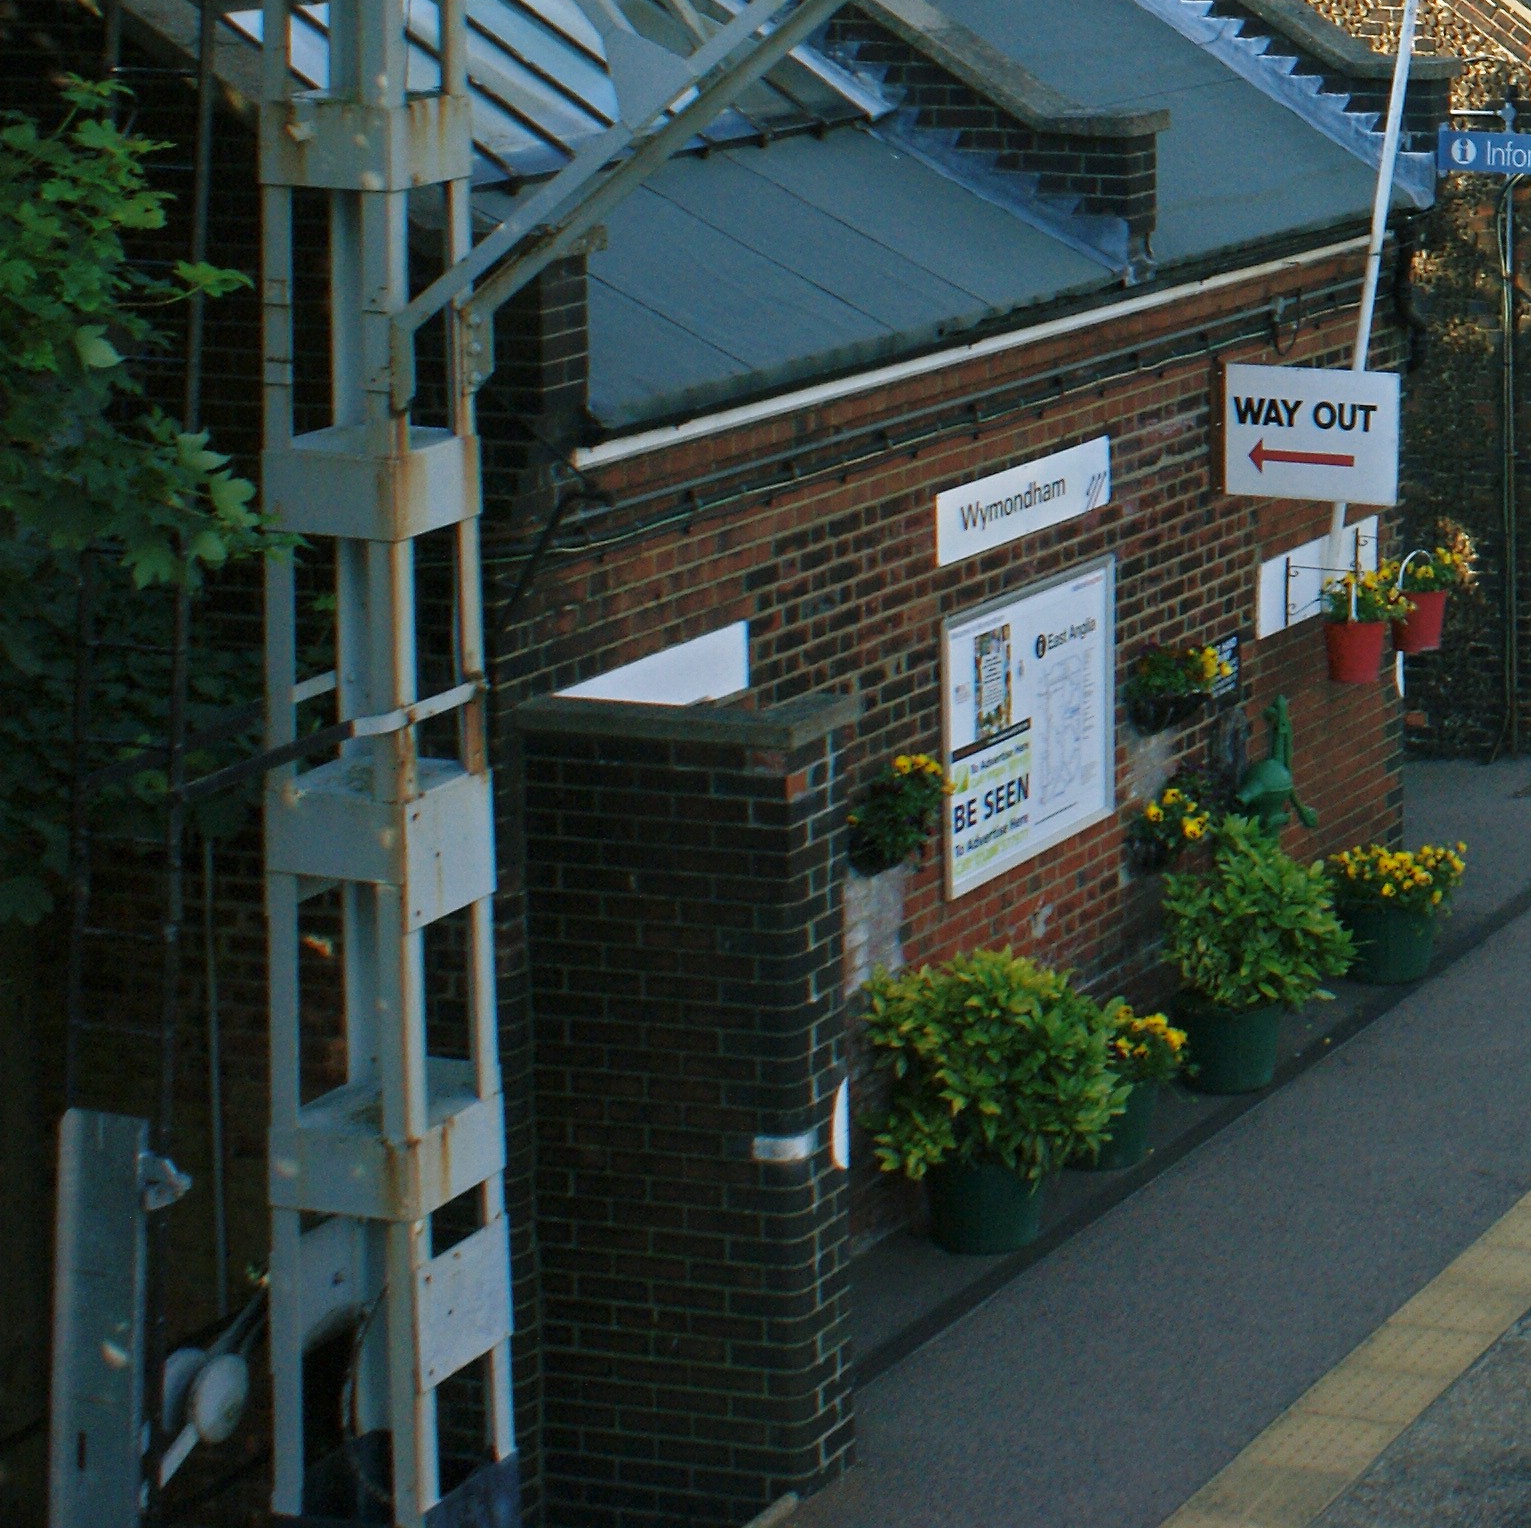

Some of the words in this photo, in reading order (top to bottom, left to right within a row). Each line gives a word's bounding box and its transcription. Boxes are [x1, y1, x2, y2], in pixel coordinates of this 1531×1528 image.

[1233, 396, 1303, 427] WAY
[1313, 401, 1378, 433] OUT
[960, 476, 1066, 532] Wymondham
[1047, 628, 1068, 651] East
[1068, 615, 1097, 640] Anglia
[954, 798, 977, 834] BE
[984, 773, 1030, 820] SEEN
